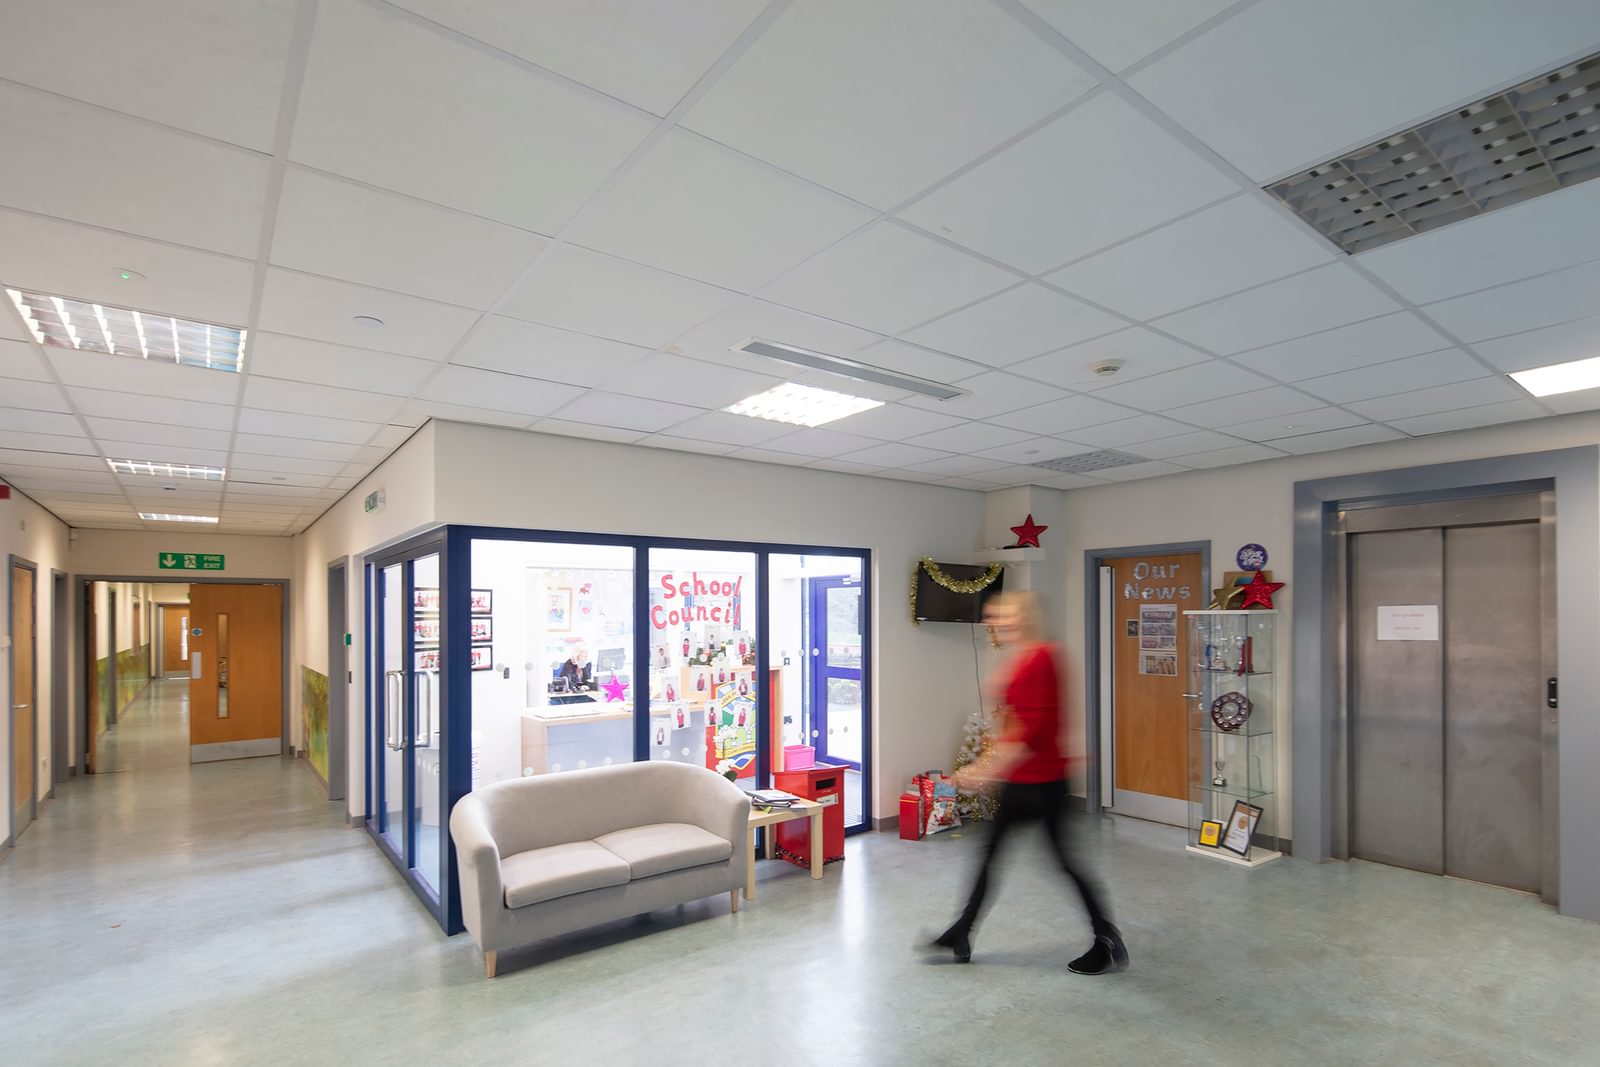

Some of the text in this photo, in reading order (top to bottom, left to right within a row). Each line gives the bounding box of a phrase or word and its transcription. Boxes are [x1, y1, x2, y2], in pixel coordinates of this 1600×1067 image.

[1134, 562, 1180, 580] Our
[661, 572, 743, 599] School
[1123, 582, 1191, 599] News
[650, 601, 741, 630] Council
